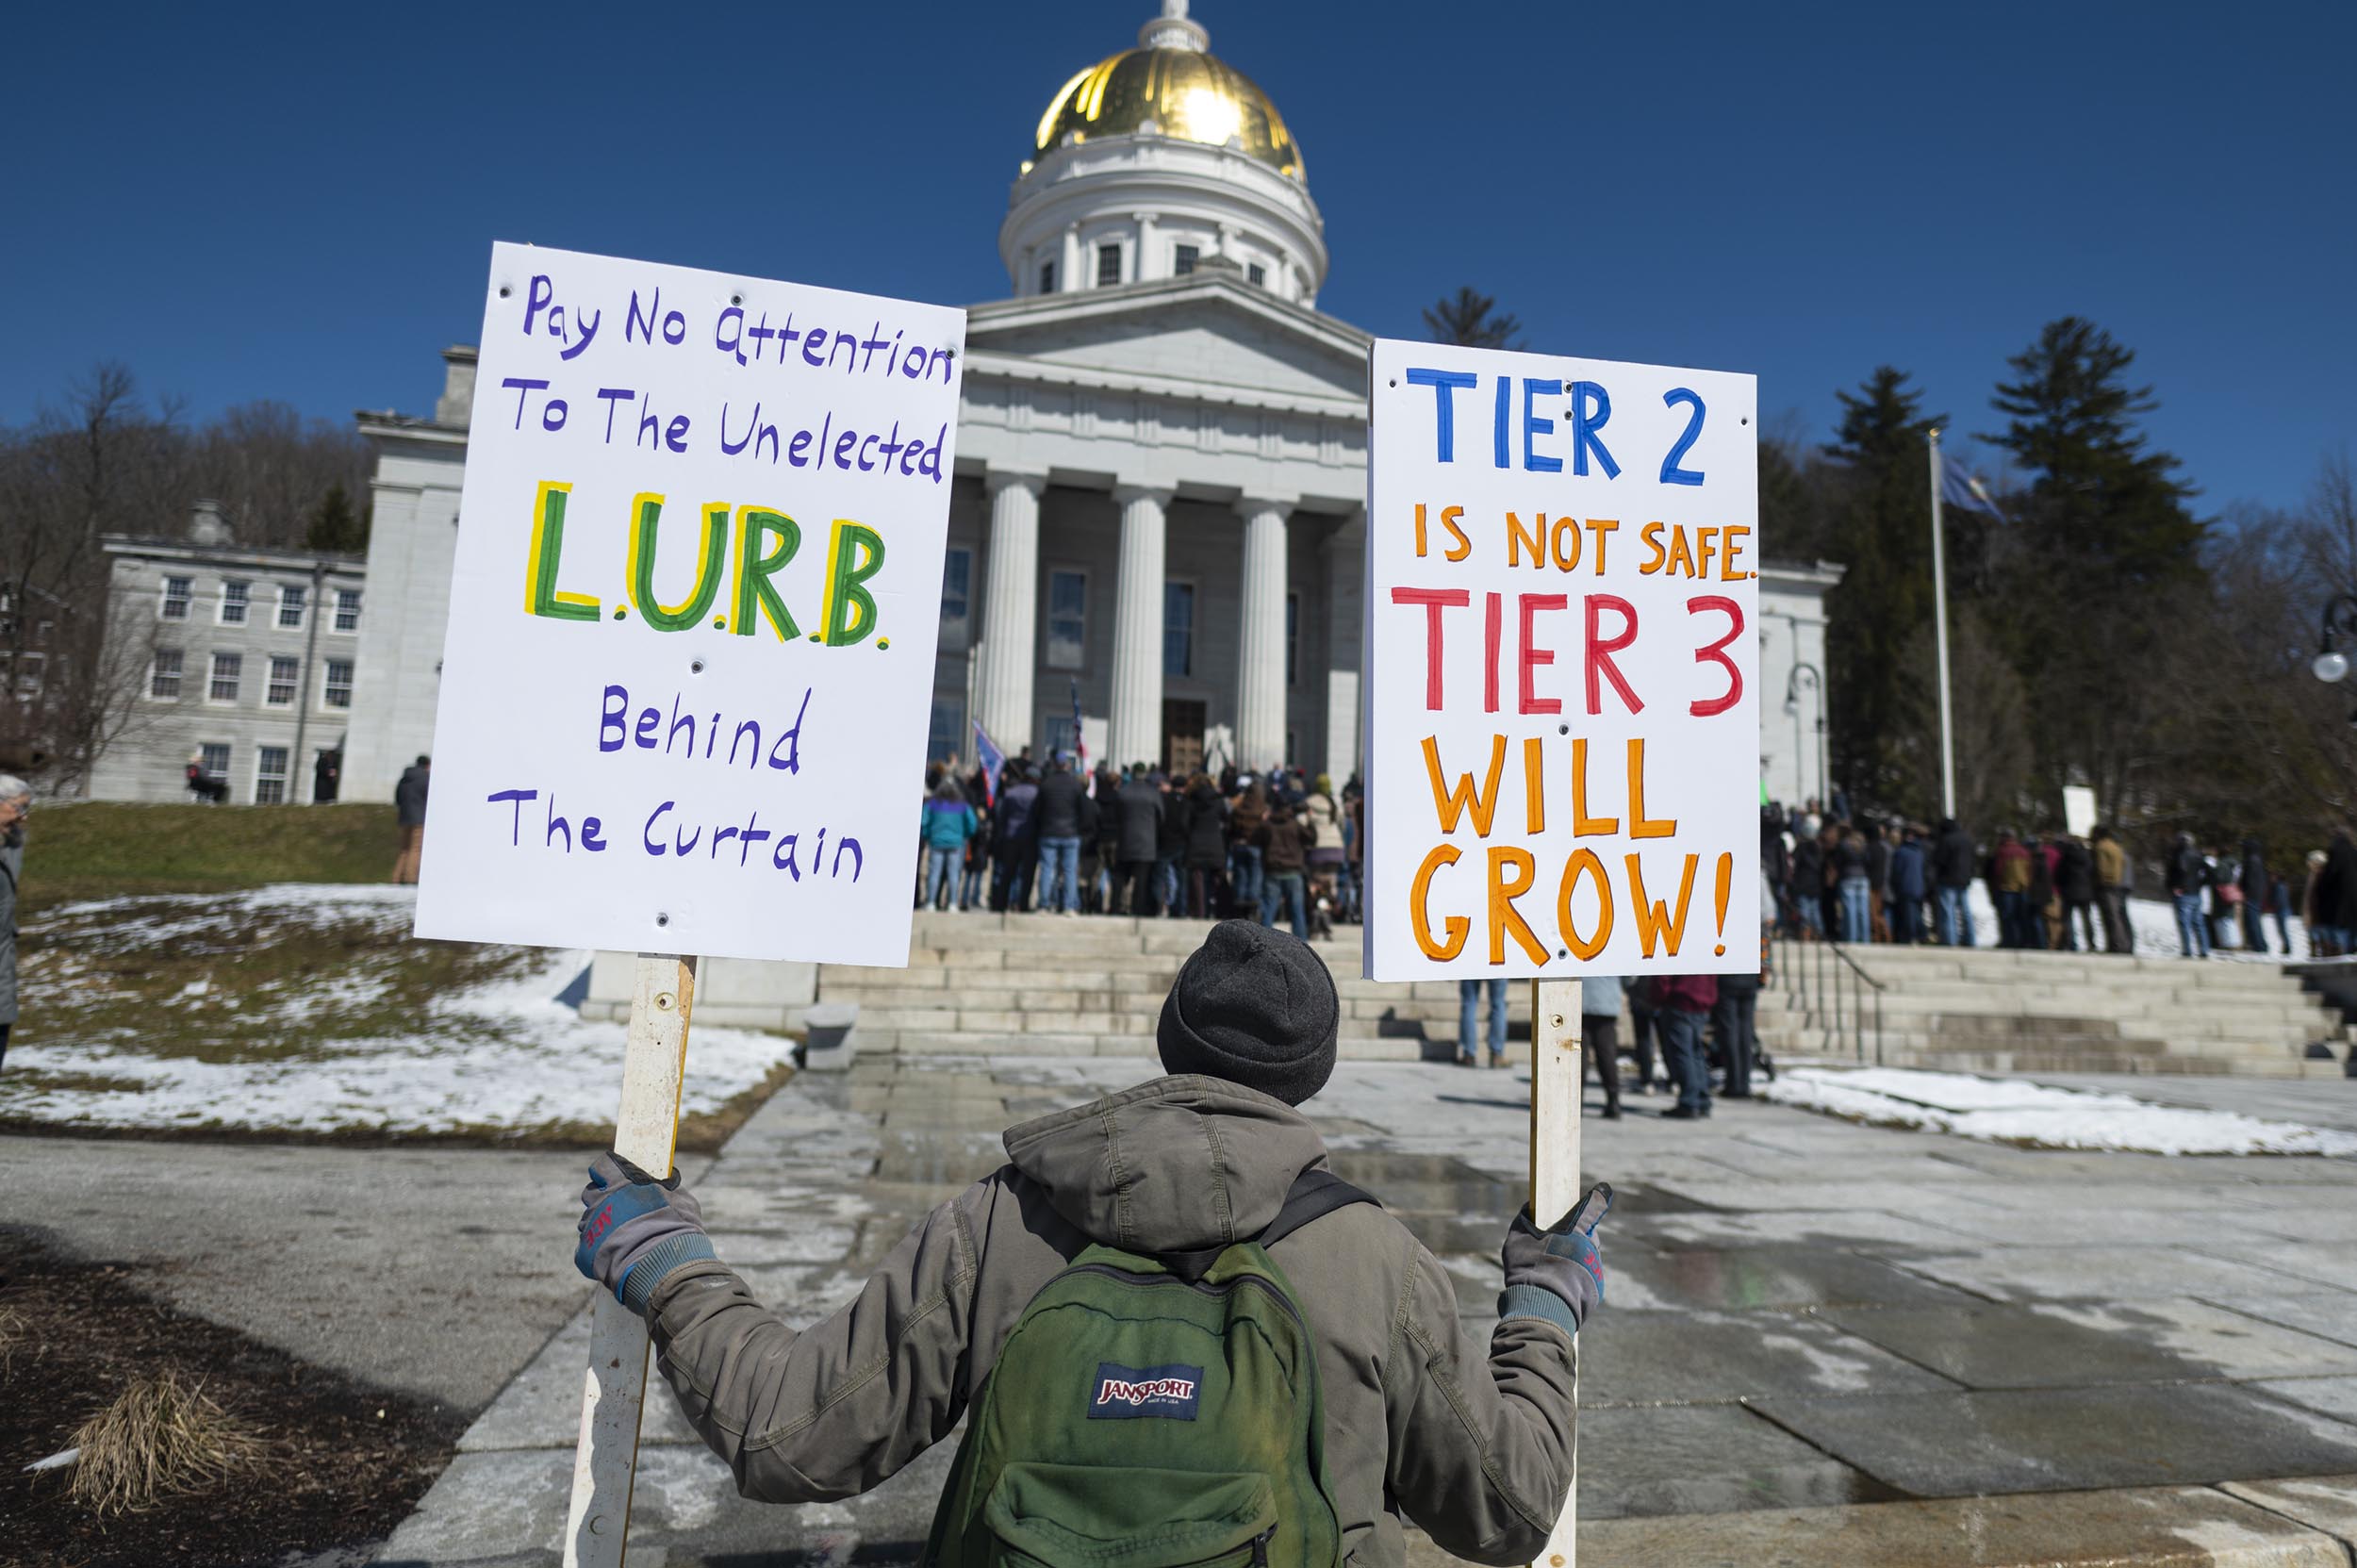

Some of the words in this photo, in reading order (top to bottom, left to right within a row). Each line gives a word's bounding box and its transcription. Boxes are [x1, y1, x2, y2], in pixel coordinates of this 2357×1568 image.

[523, 275, 601, 361] Pay
[626, 287, 685, 346] No
[503, 377, 568, 432] To
[598, 388, 690, 453] The
[722, 402, 947, 484] Unelected
[1407, 368, 1622, 480] TIER
[1659, 388, 1706, 487] 2
[524, 480, 890, 650] L.U.R.B.
[1415, 503, 1471, 563] IS
[1506, 512, 1620, 576] NOT
[1639, 521, 1759, 582] SAFE.
[1391, 586, 1645, 716] TIER
[1687, 595, 1745, 718] 3
[600, 685, 813, 775] Behind
[487, 790, 607, 853] The
[644, 801, 863, 883] Curtain
[1421, 734, 1677, 839] WILL
[1410, 843, 1733, 967] GROW!
